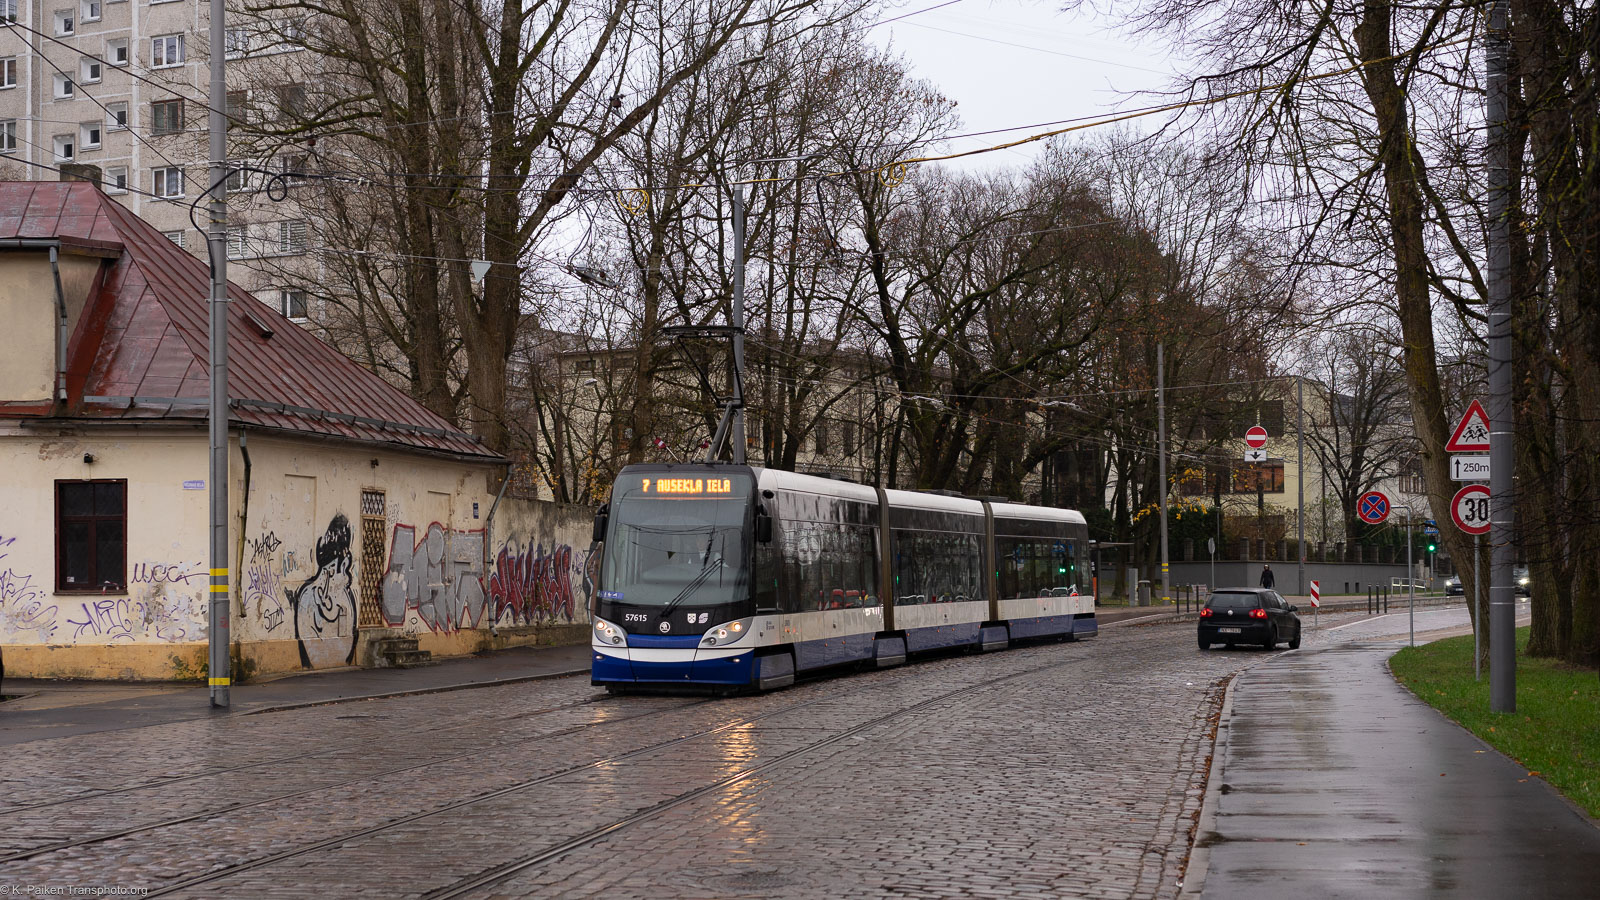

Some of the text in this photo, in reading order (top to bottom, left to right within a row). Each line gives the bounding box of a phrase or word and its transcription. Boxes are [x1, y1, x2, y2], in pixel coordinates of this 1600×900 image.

[1463, 462, 1489, 473] 250m
[642, 478, 650, 493] 7
[706, 479, 731, 493] IELA
[1464, 499, 1488, 522] 30
[625, 613, 647, 622] 57615
